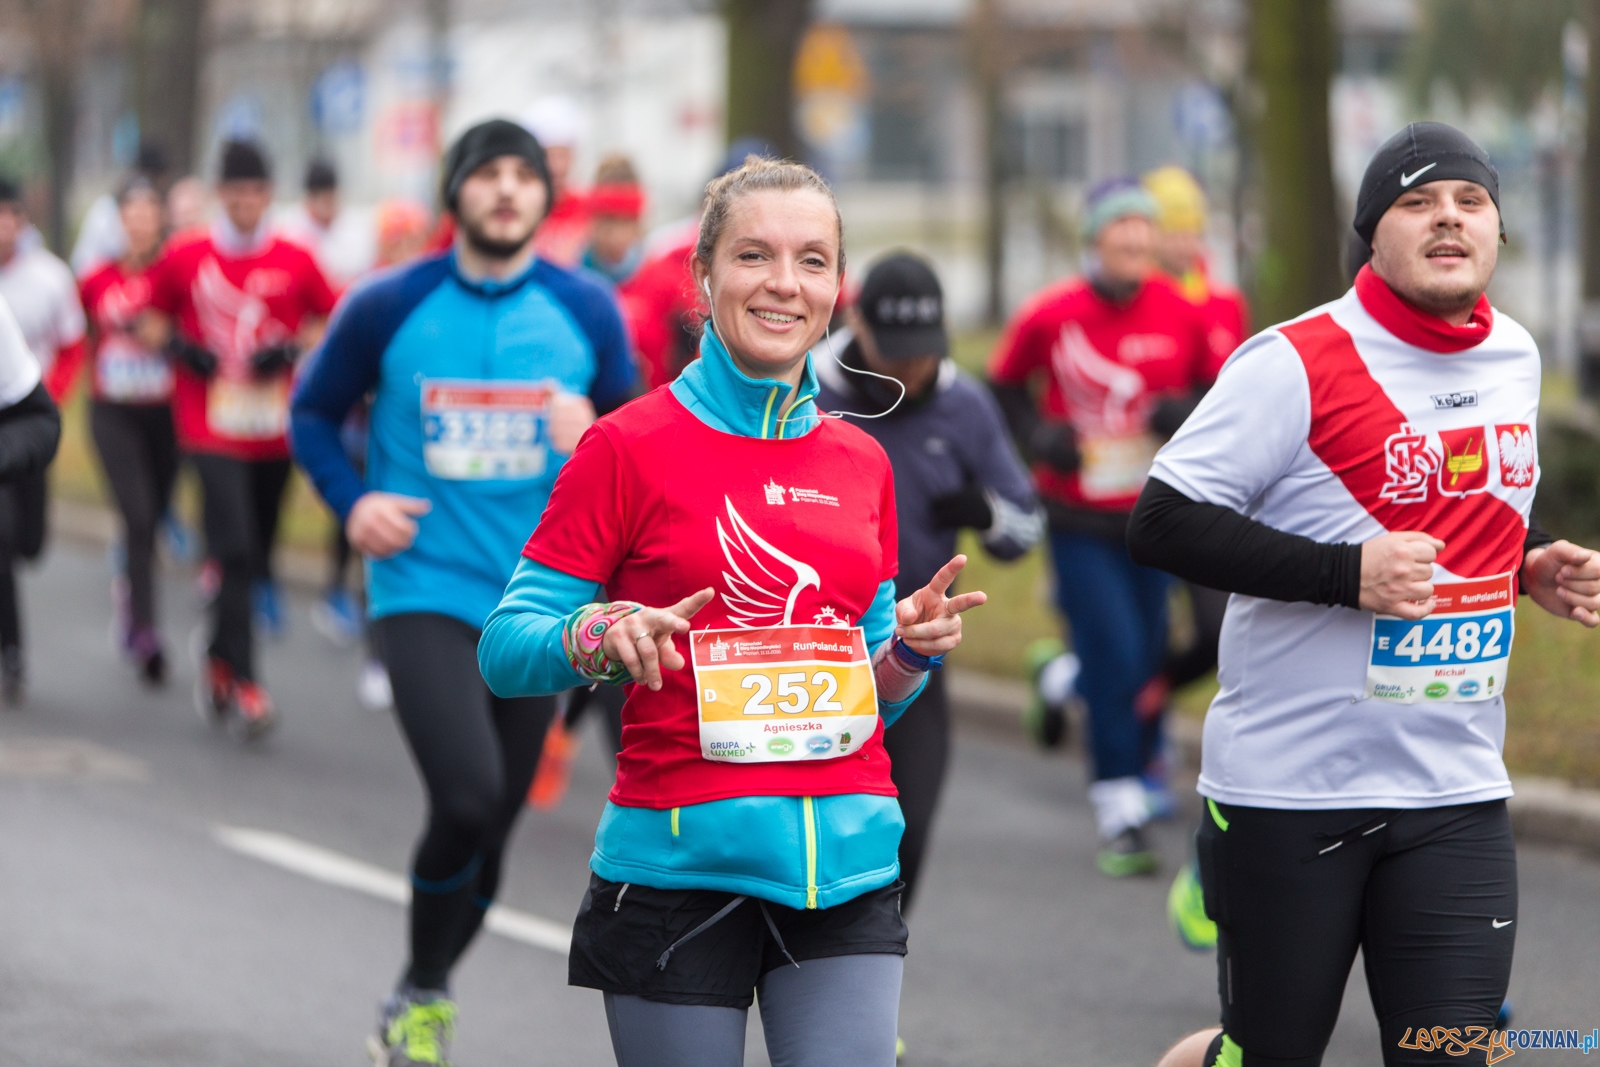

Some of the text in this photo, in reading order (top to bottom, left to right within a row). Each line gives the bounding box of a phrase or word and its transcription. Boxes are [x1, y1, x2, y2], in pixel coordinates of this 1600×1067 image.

[1461, 590, 1508, 604] RunPoland.org
[1377, 618, 1503, 662] E 4482
[793, 641, 853, 655] RunPoland.org
[704, 671, 843, 715] D 252
[763, 722, 823, 734] Agnieszka
[710, 741, 739, 750] GRUPA
[710, 748, 746, 757] LUXMED
